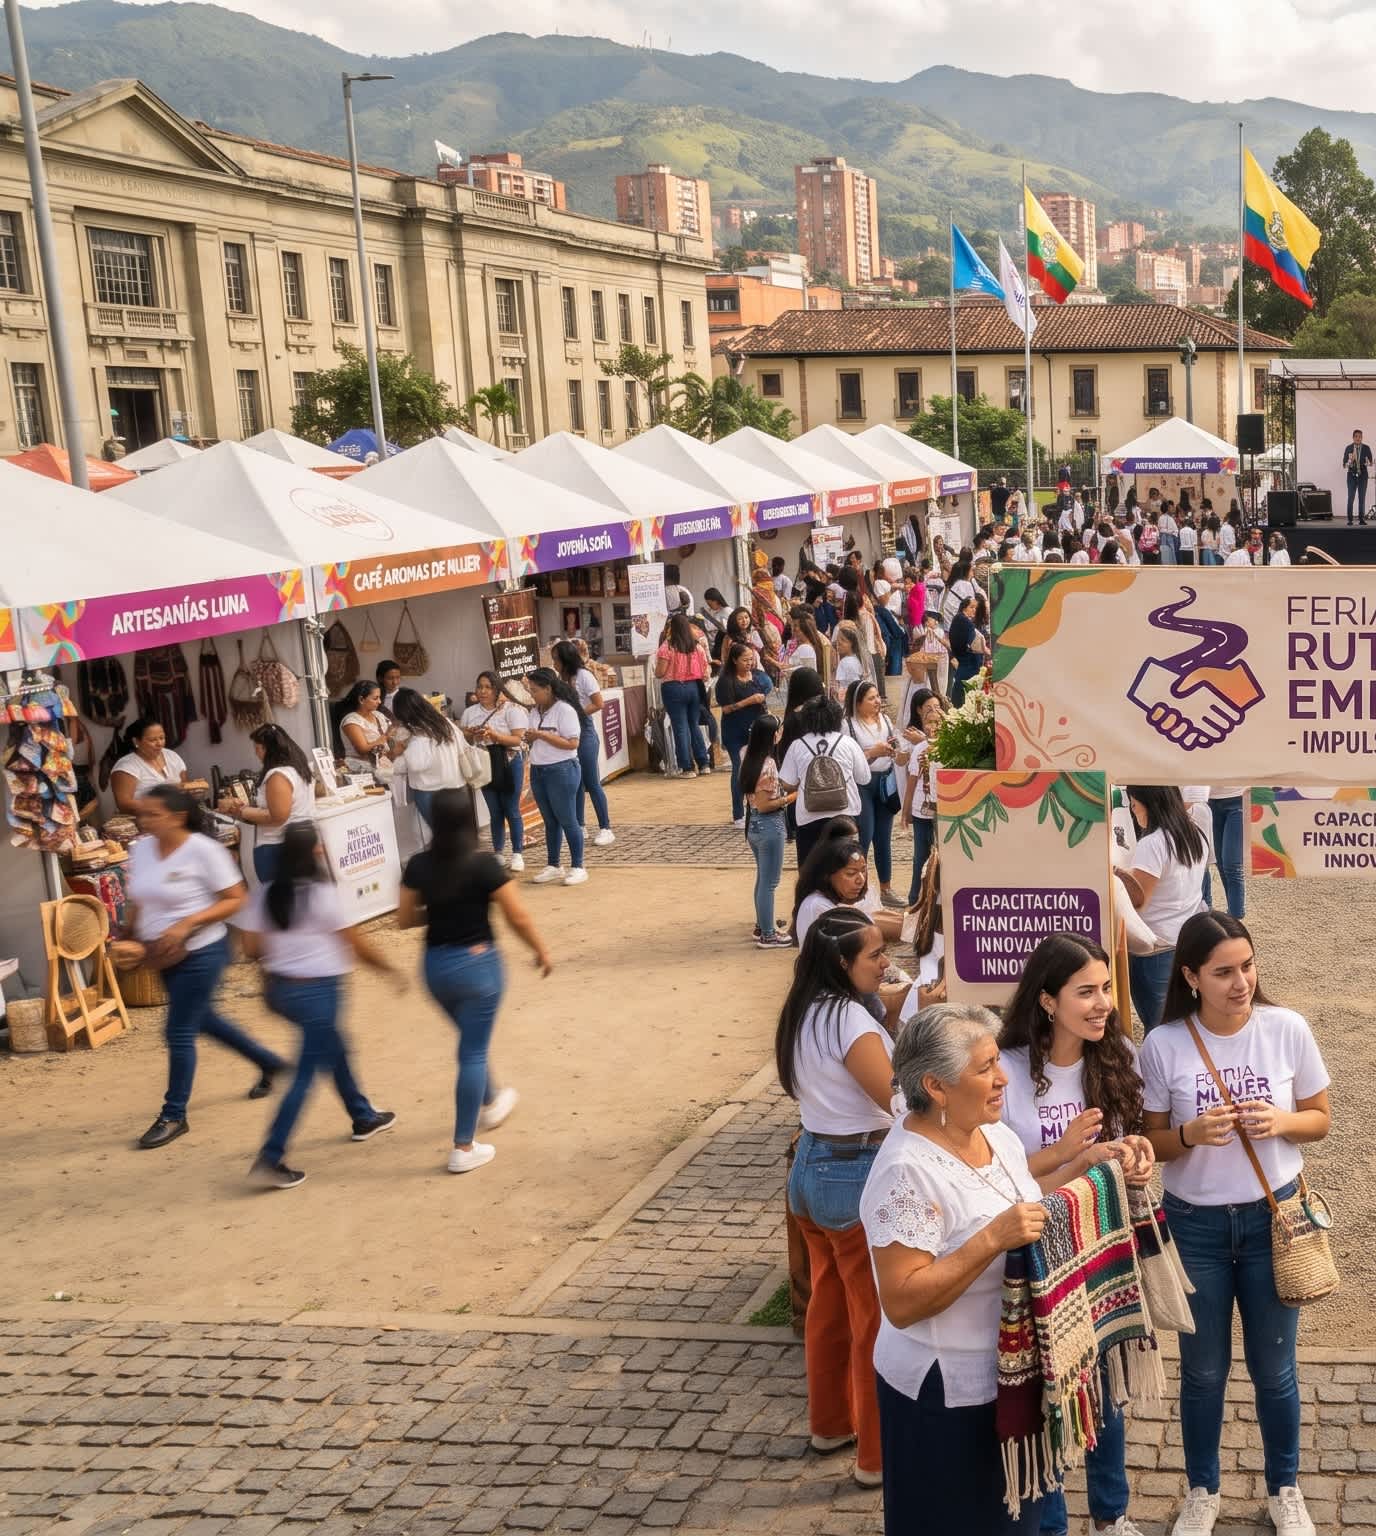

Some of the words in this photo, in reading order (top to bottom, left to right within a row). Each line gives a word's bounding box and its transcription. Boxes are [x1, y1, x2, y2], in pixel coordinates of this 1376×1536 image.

[353, 563, 384, 592] CAFÉ
[384, 563, 431, 586] AROMAS
[431, 561, 446, 580] DE
[111, 595, 209, 636] ARTESANÍAS
[211, 593, 250, 618] LUNA
[972, 891, 1085, 913] CAPACITACIÓN,
[962, 915, 1093, 932] FINANCIAMIENTO
